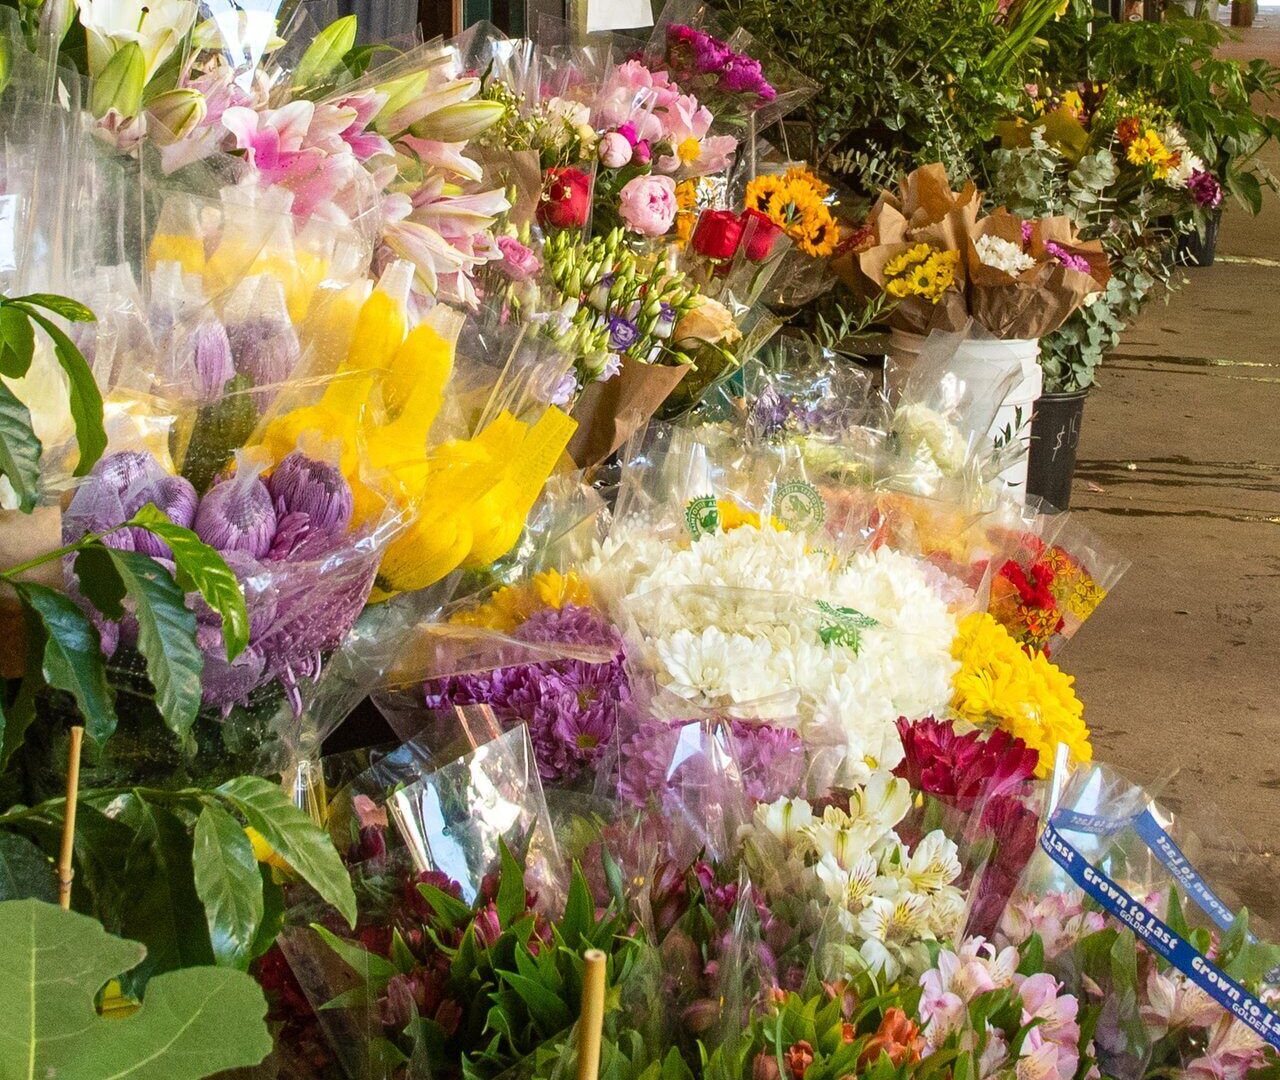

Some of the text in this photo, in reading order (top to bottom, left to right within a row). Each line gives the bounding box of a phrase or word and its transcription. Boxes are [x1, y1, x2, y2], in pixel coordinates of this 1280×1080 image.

[1050, 833, 1074, 863] Last
[1083, 867, 1178, 950] Grown to Last
[1119, 909, 1151, 938] GOLDEN
[1191, 956, 1241, 1002] Grown
[1242, 998, 1261, 1017] to
[1231, 1002, 1269, 1035] GOLDEN
